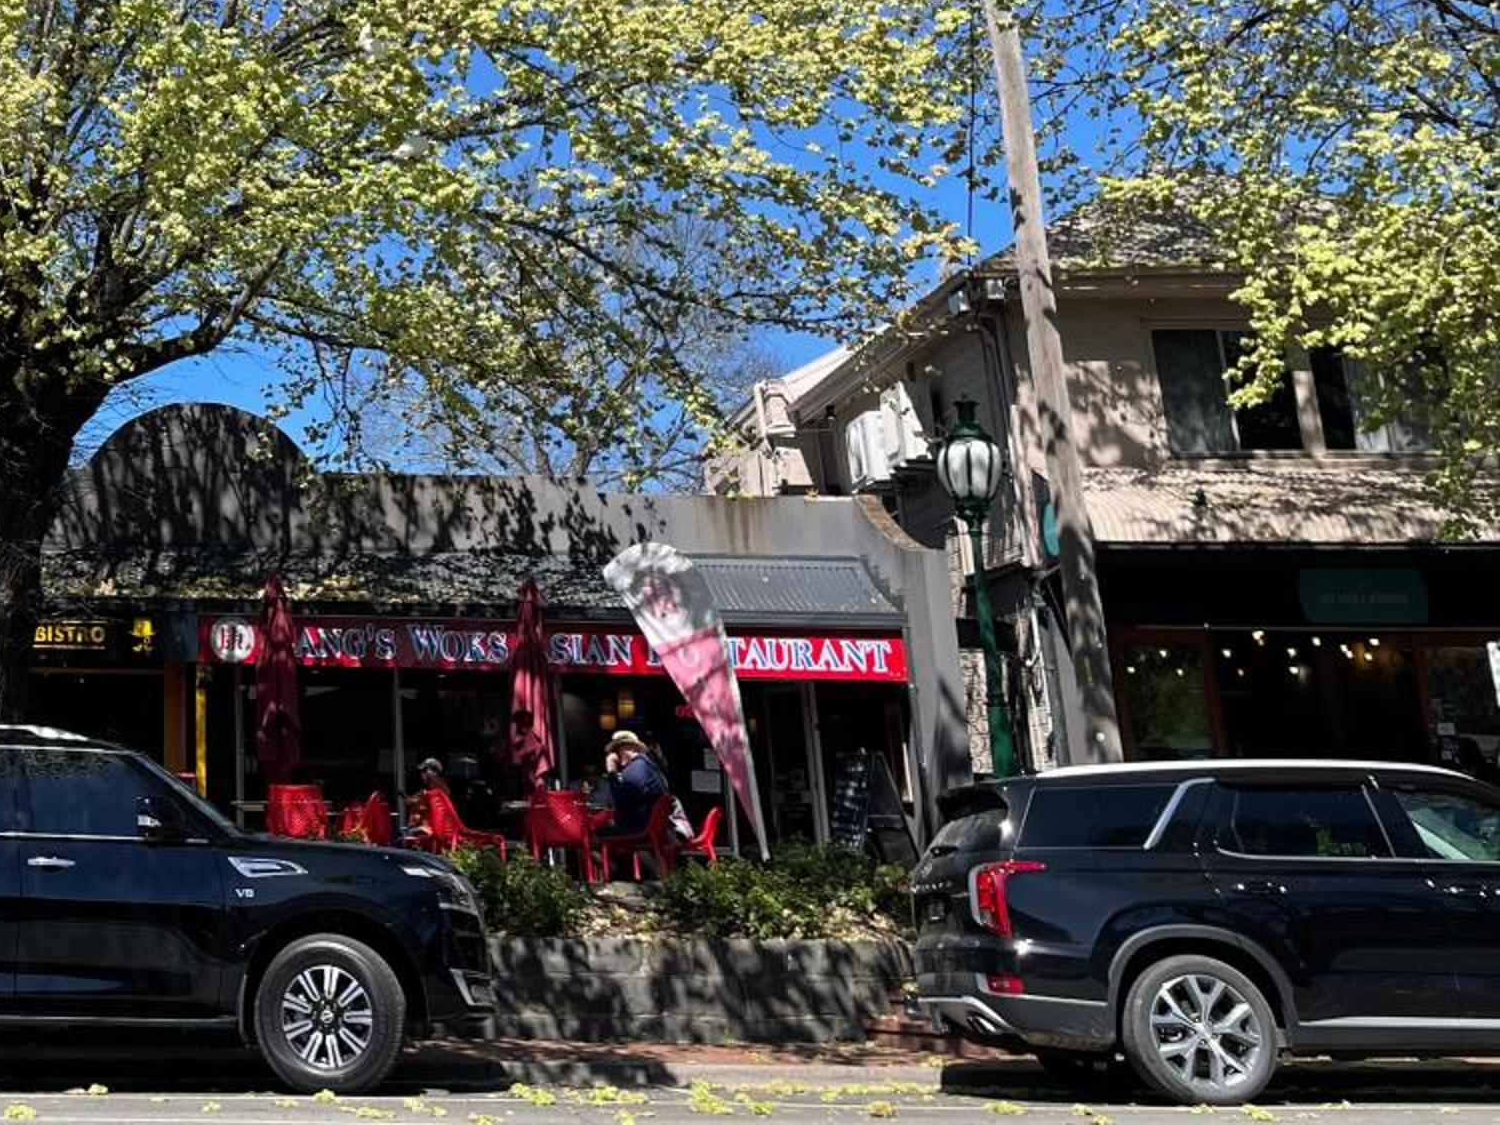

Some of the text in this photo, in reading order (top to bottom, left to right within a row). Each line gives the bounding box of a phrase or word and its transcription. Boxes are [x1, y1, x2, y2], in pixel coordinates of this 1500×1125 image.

[34, 626, 106, 642] BISTRO
[293, 623, 893, 673] ANG'S WOKS SIAN TAURANT
